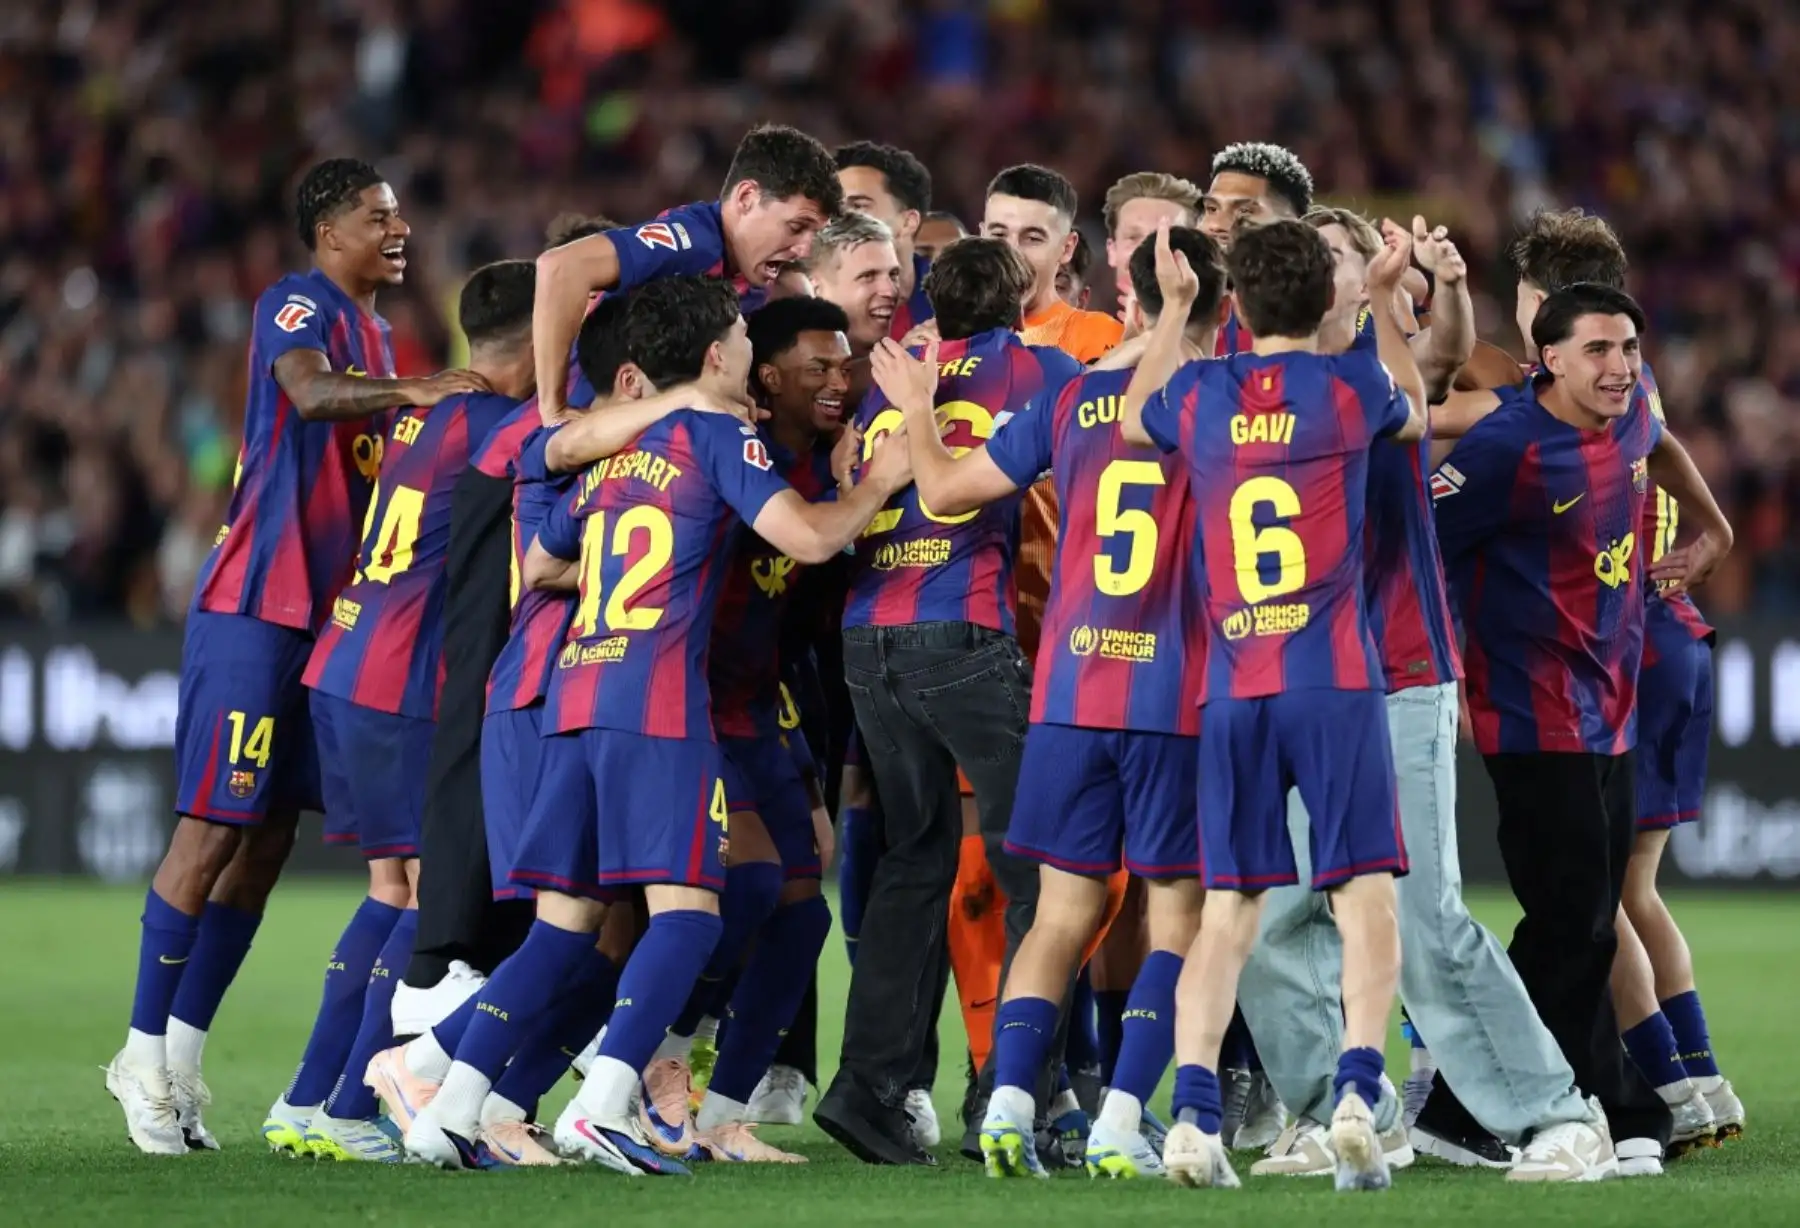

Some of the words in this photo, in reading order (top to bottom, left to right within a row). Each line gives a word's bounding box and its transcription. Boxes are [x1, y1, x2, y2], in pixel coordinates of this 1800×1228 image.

[1230, 413, 1296, 445] GAVI
[1093, 460, 1166, 596] 5
[904, 538, 952, 552] UNHCR
[1230, 476, 1306, 604] 6
[1254, 604, 1310, 619] UNHCR
[1255, 616, 1308, 632] ACNUR
[1101, 629, 1156, 646] UNHCR
[582, 645, 626, 660] ACNUR
[1100, 642, 1155, 658] ACNUR
[227, 710, 275, 768] 14
[708, 777, 728, 832] 4
